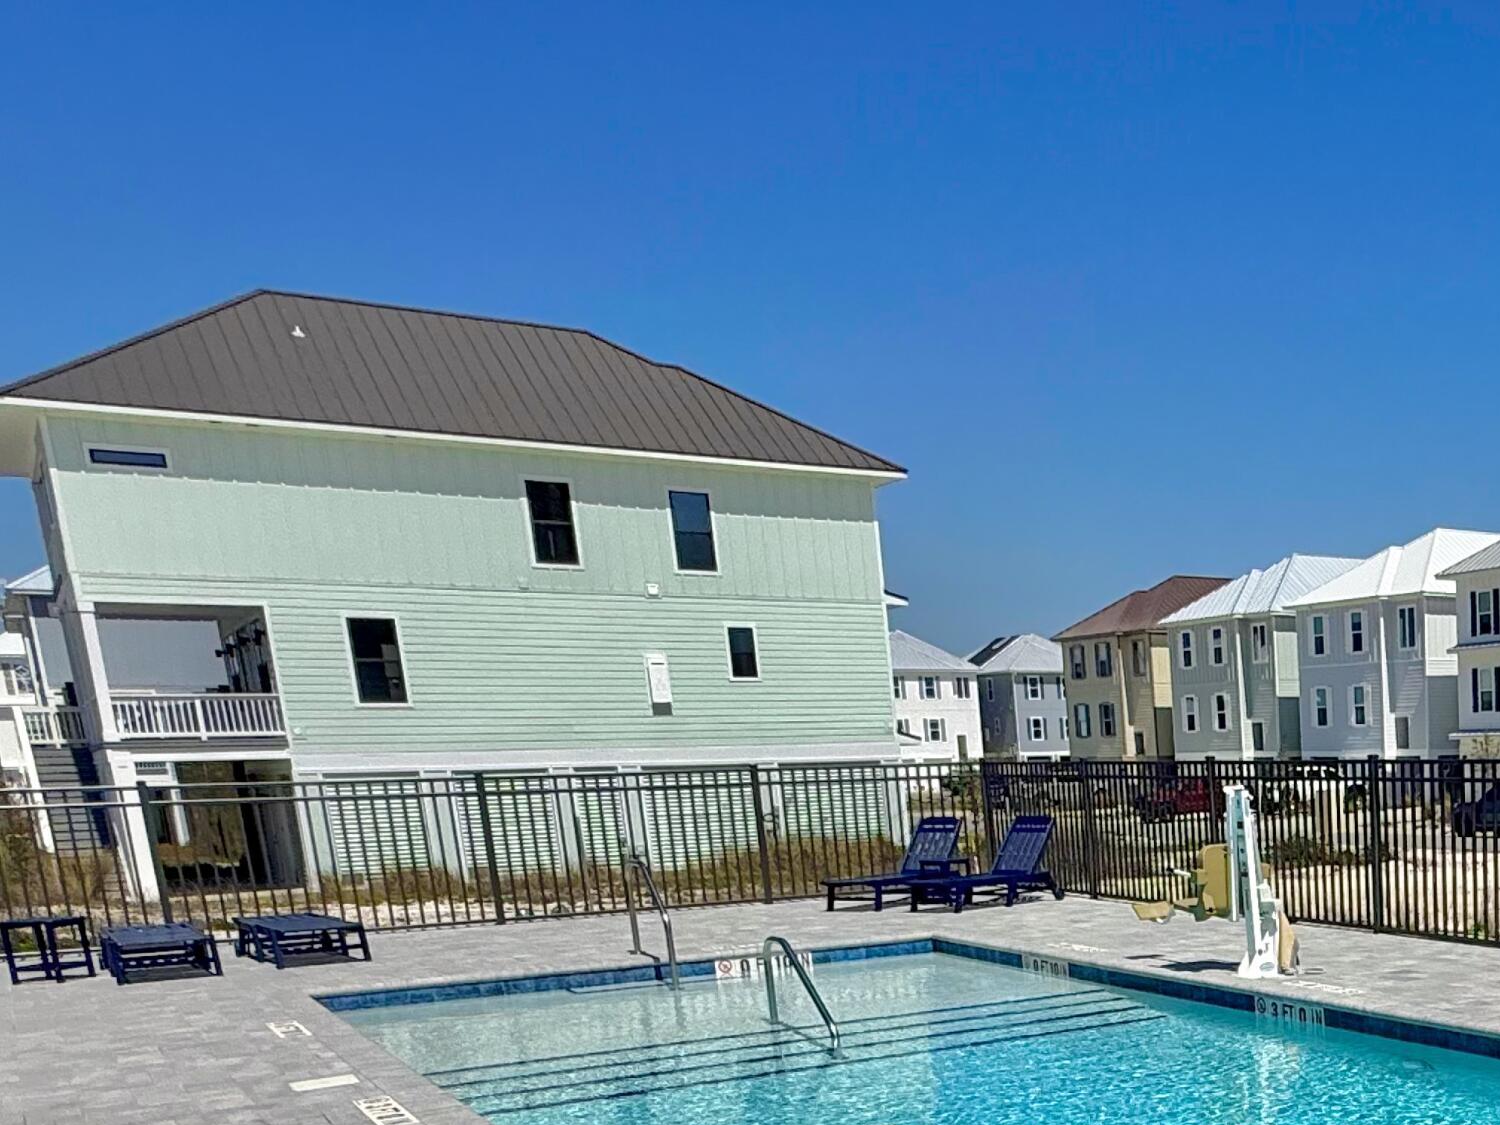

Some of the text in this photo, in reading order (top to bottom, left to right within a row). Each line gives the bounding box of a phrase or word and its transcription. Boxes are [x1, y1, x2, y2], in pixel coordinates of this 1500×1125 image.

[1271, 1002, 1278, 1017] 3
[1283, 1003, 1294, 1019] FT
[1311, 1007, 1322, 1025] IN
